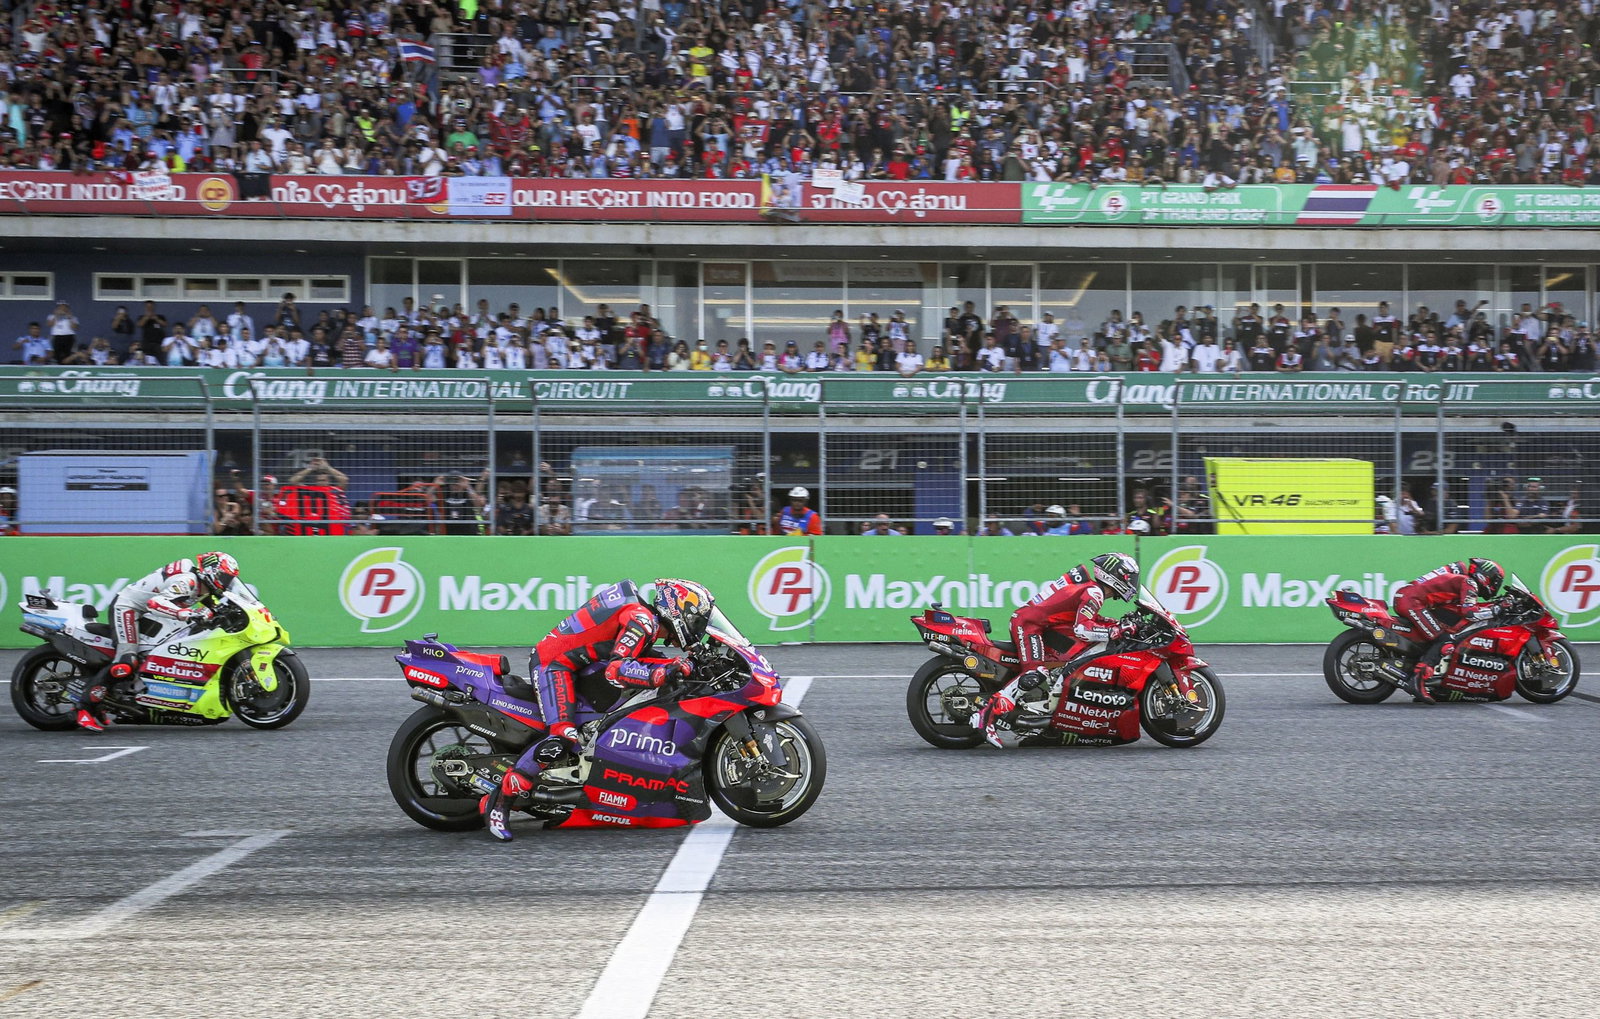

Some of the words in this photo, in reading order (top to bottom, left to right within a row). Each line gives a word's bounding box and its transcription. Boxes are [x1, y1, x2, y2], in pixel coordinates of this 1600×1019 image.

[71, 183, 122, 200] INTO
[127, 184, 187, 200] FD
[405, 176, 442, 199] 93
[513, 189, 556, 206] OUR
[647, 190, 690, 207] INTO
[699, 191, 755, 208] FOOD
[1160, 191, 1207, 205] GRAND
[57, 370, 141, 396] Chang
[223, 371, 328, 405] Chang
[333, 380, 526, 399] INTERNATIONAL
[533, 382, 633, 399] CIRCUIT
[1191, 383, 1374, 401] INTERNATIONAL
[1382, 384, 1479, 401] CRCUIT
[859, 450, 898, 470] 21
[1131, 450, 1173, 470] 22
[1391, 624, 1412, 632] Lenovo
[1422, 609, 1441, 632] Lenovo
[620, 636, 636, 647] 89
[1470, 637, 1494, 649] GIVI
[167, 643, 210, 661] ebay
[423, 647, 444, 658] KILO
[1001, 655, 1020, 664] Lenov
[146, 662, 203, 678] Enduro
[1462, 653, 1504, 671] Lenovo
[408, 669, 441, 685] MOTUL
[455, 665, 484, 679] prima
[1083, 666, 1114, 680] GIVI
[554, 671, 569, 720] PRAMAC
[1074, 686, 1127, 706] Lenovo
[491, 698, 507, 709] LINO
[507, 702, 533, 716] SONEGO
[1058, 712, 1081, 722] SIEMENS
[610, 728, 677, 756] prima
[603, 768, 690, 794] PRAMAC
[599, 791, 628, 806] FIAMM
[592, 813, 632, 825] MOTUL
